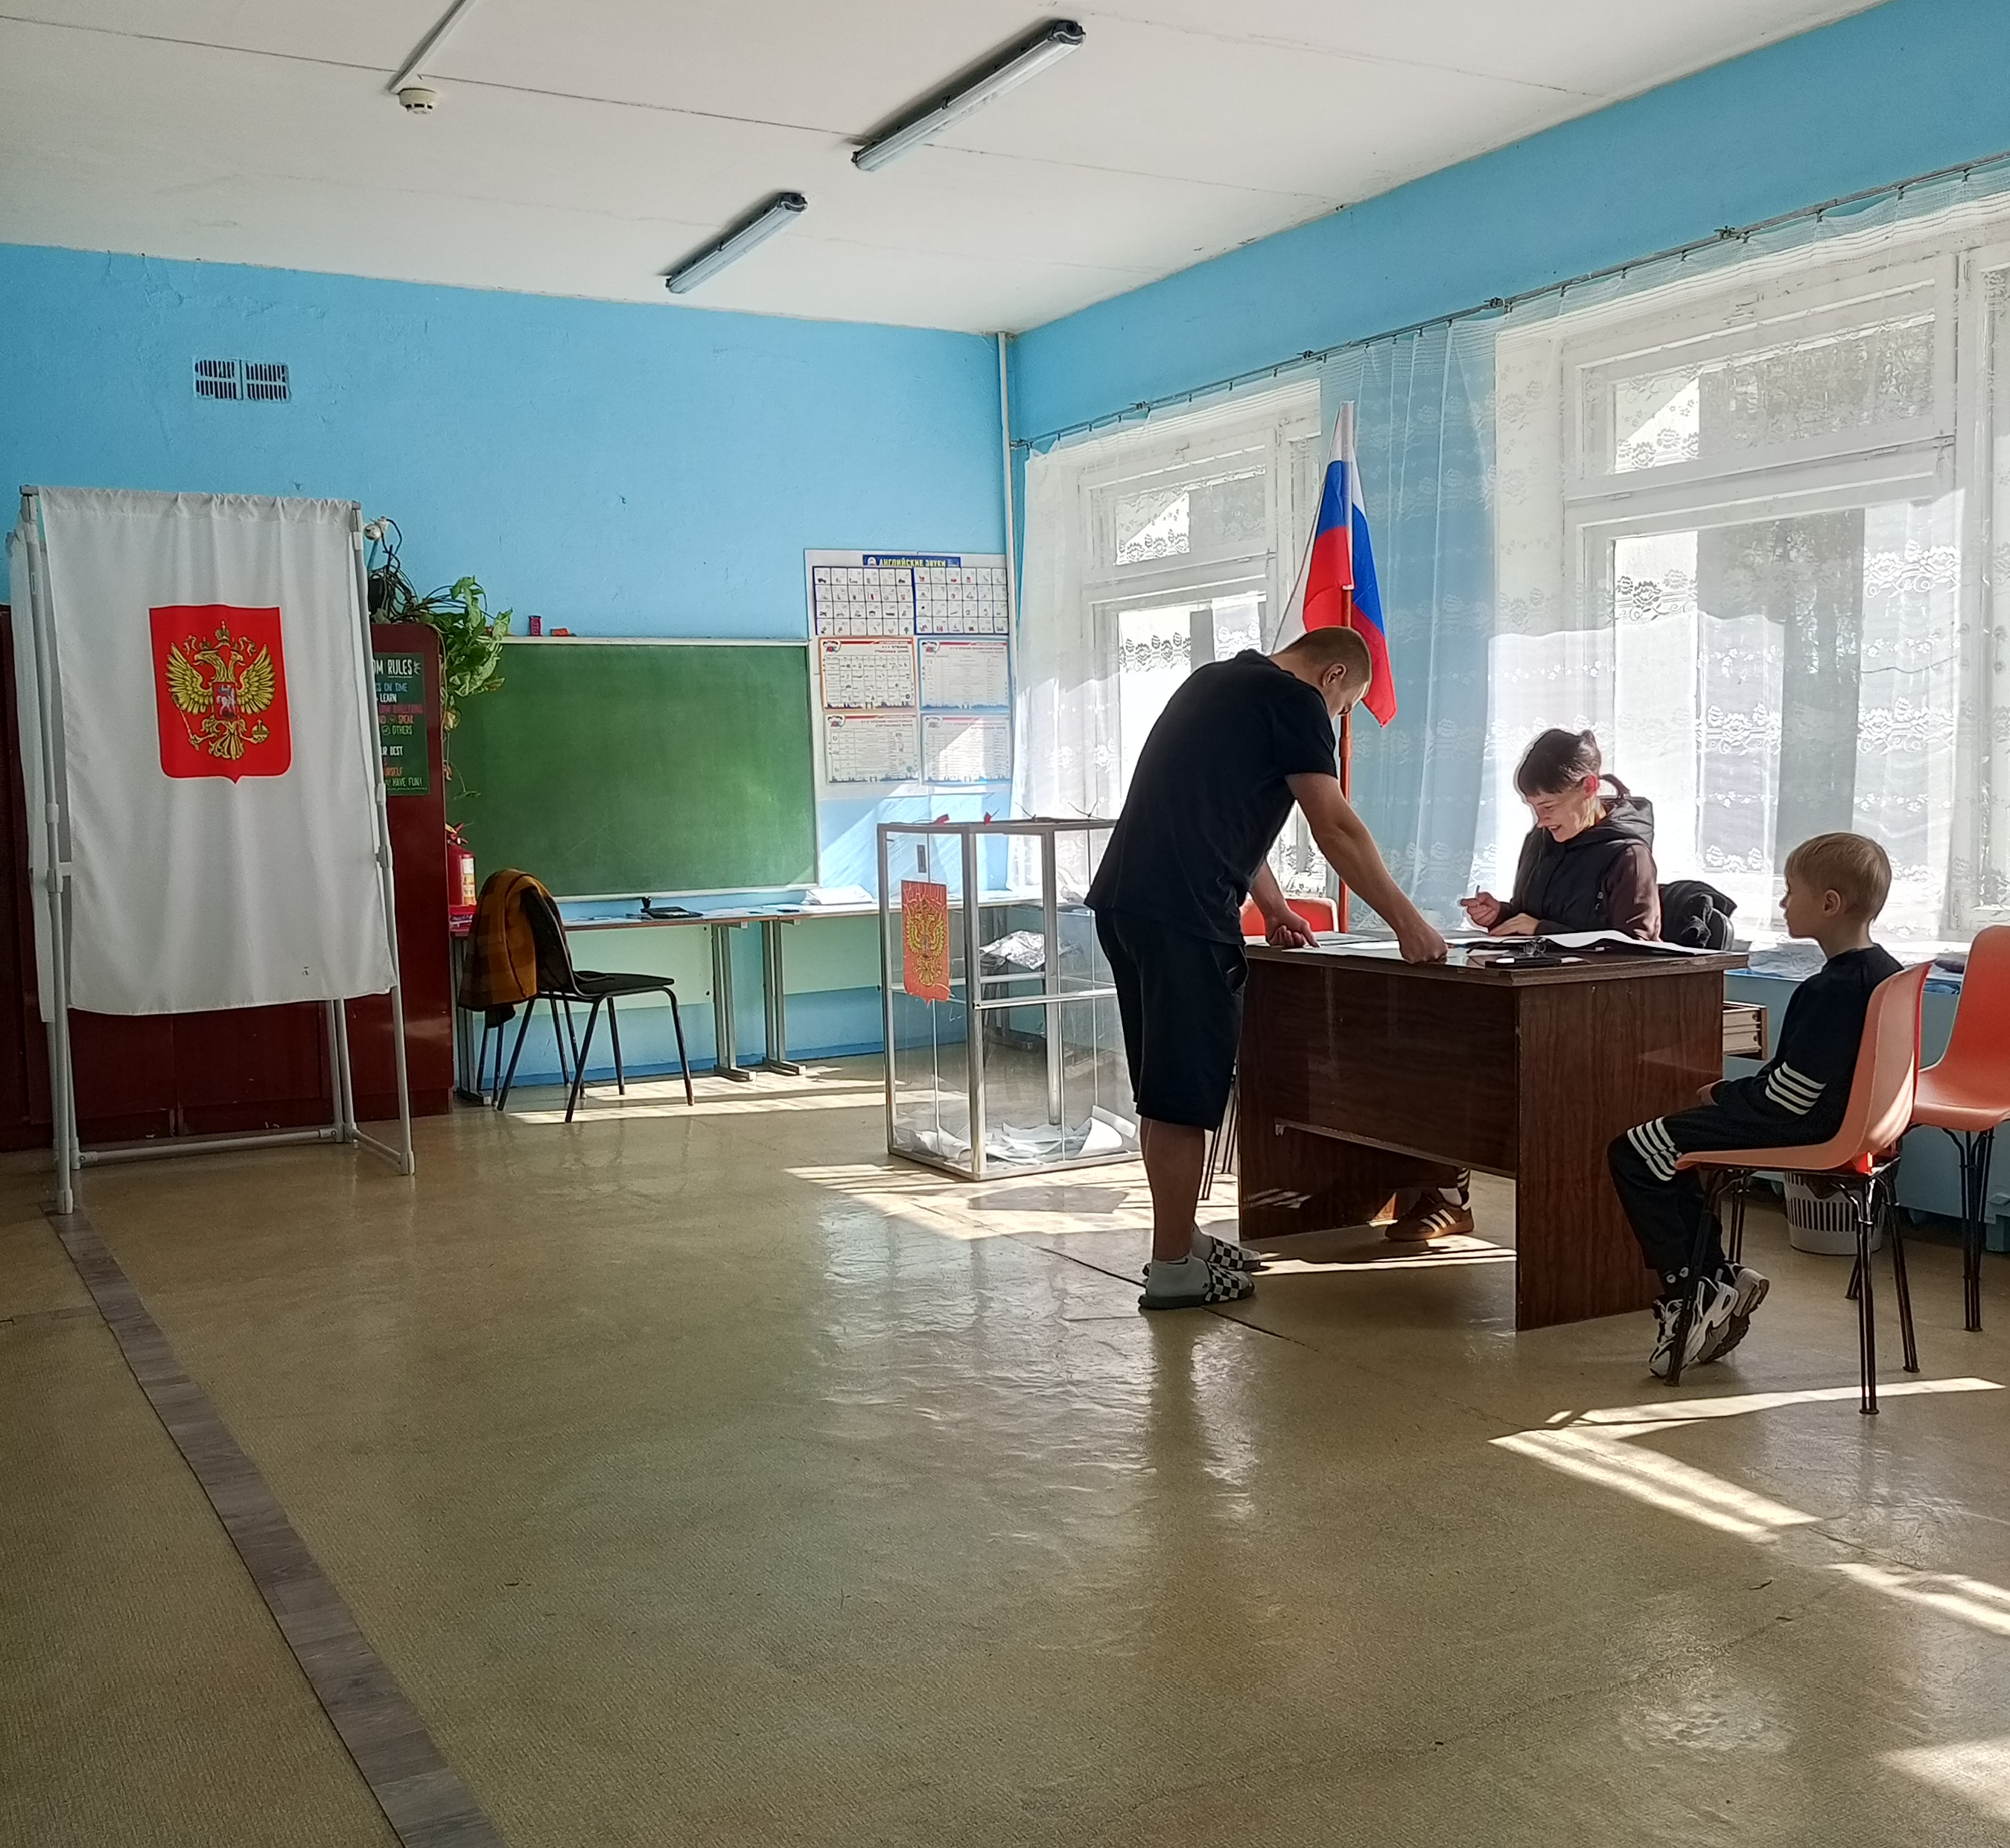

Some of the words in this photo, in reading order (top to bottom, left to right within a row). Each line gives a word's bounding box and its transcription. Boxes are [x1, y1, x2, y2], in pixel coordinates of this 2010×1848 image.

[880, 558, 923, 567] АНГЛИЙСКИЕ
[925, 559, 946, 567] ЗВУКИ
[387, 659, 413, 675] RULES
[379, 692, 398, 703] LEARN
[392, 724, 413, 736] OTHERS
[389, 745, 404, 756] BEST
[408, 777, 422, 787] FUN!
